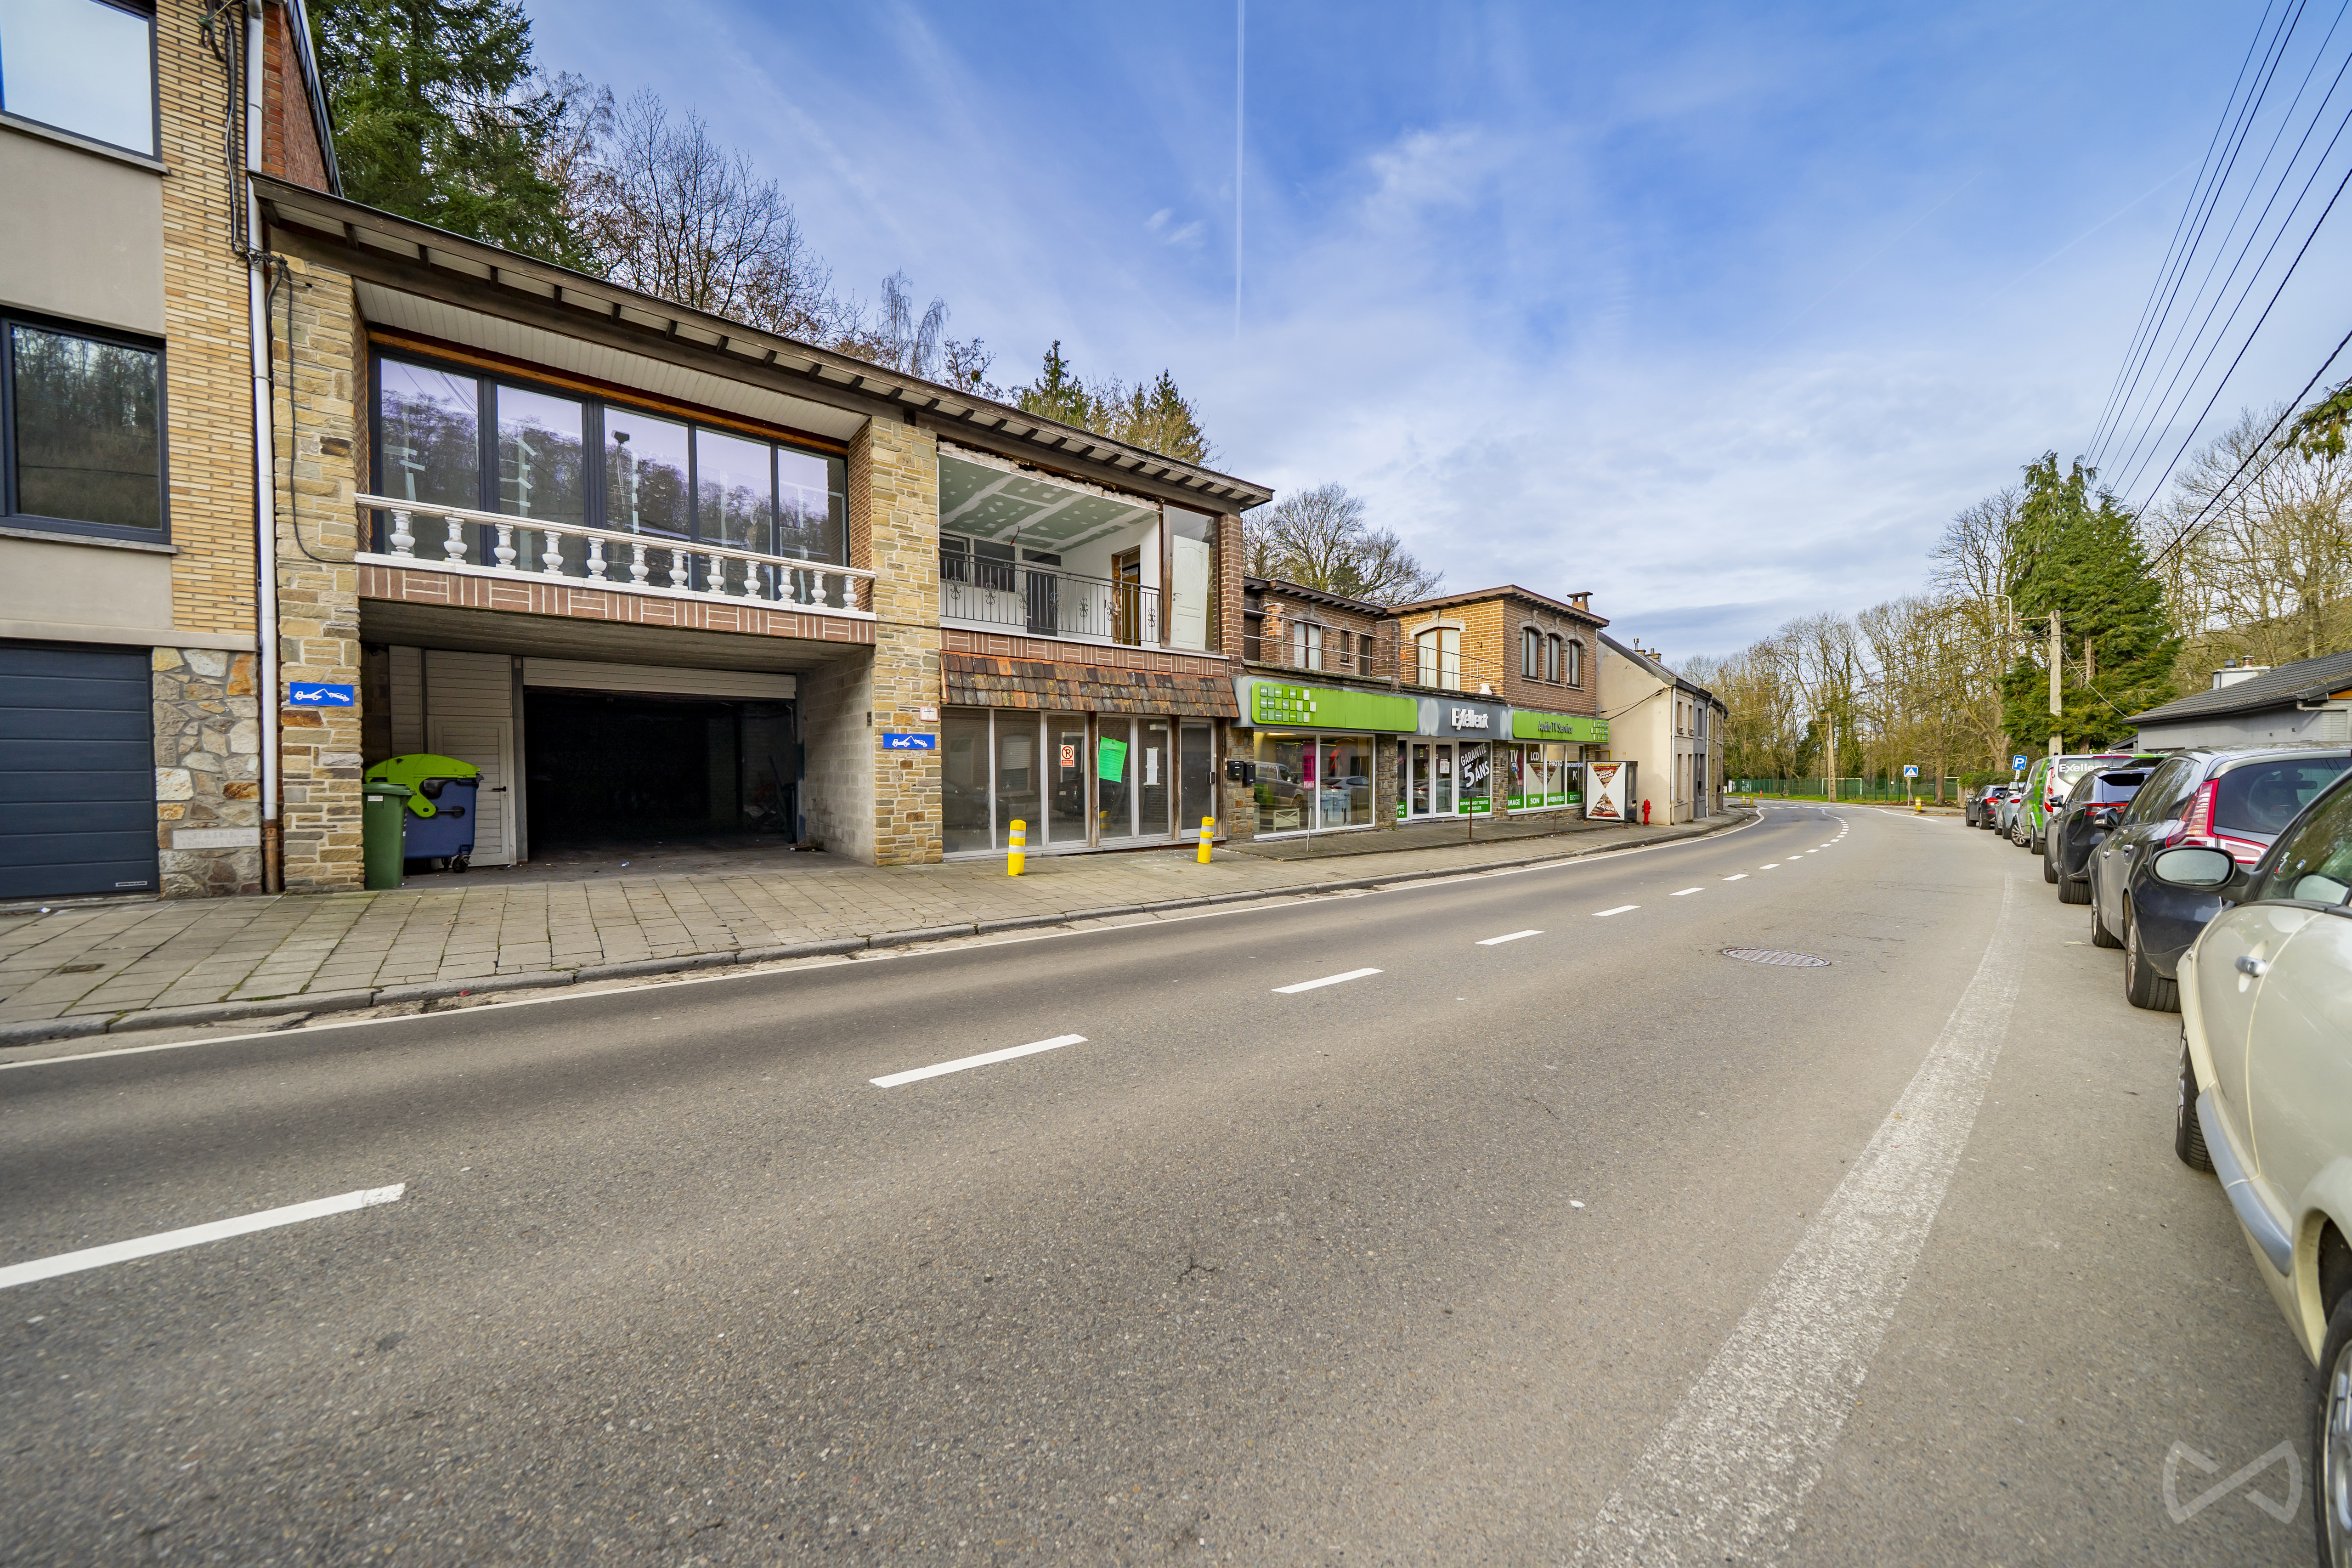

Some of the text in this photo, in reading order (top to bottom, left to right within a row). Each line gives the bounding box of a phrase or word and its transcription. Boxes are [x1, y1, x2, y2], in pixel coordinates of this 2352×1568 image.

[1538, 721, 1573, 734] Audio TV Service
[1461, 743, 1487, 766] GARANTIE
[1510, 749, 1518, 762] TV
[1531, 752, 1539, 761] LCD
[1464, 761, 1490, 787] 5 ANS
[1573, 770, 1577, 780] PC
